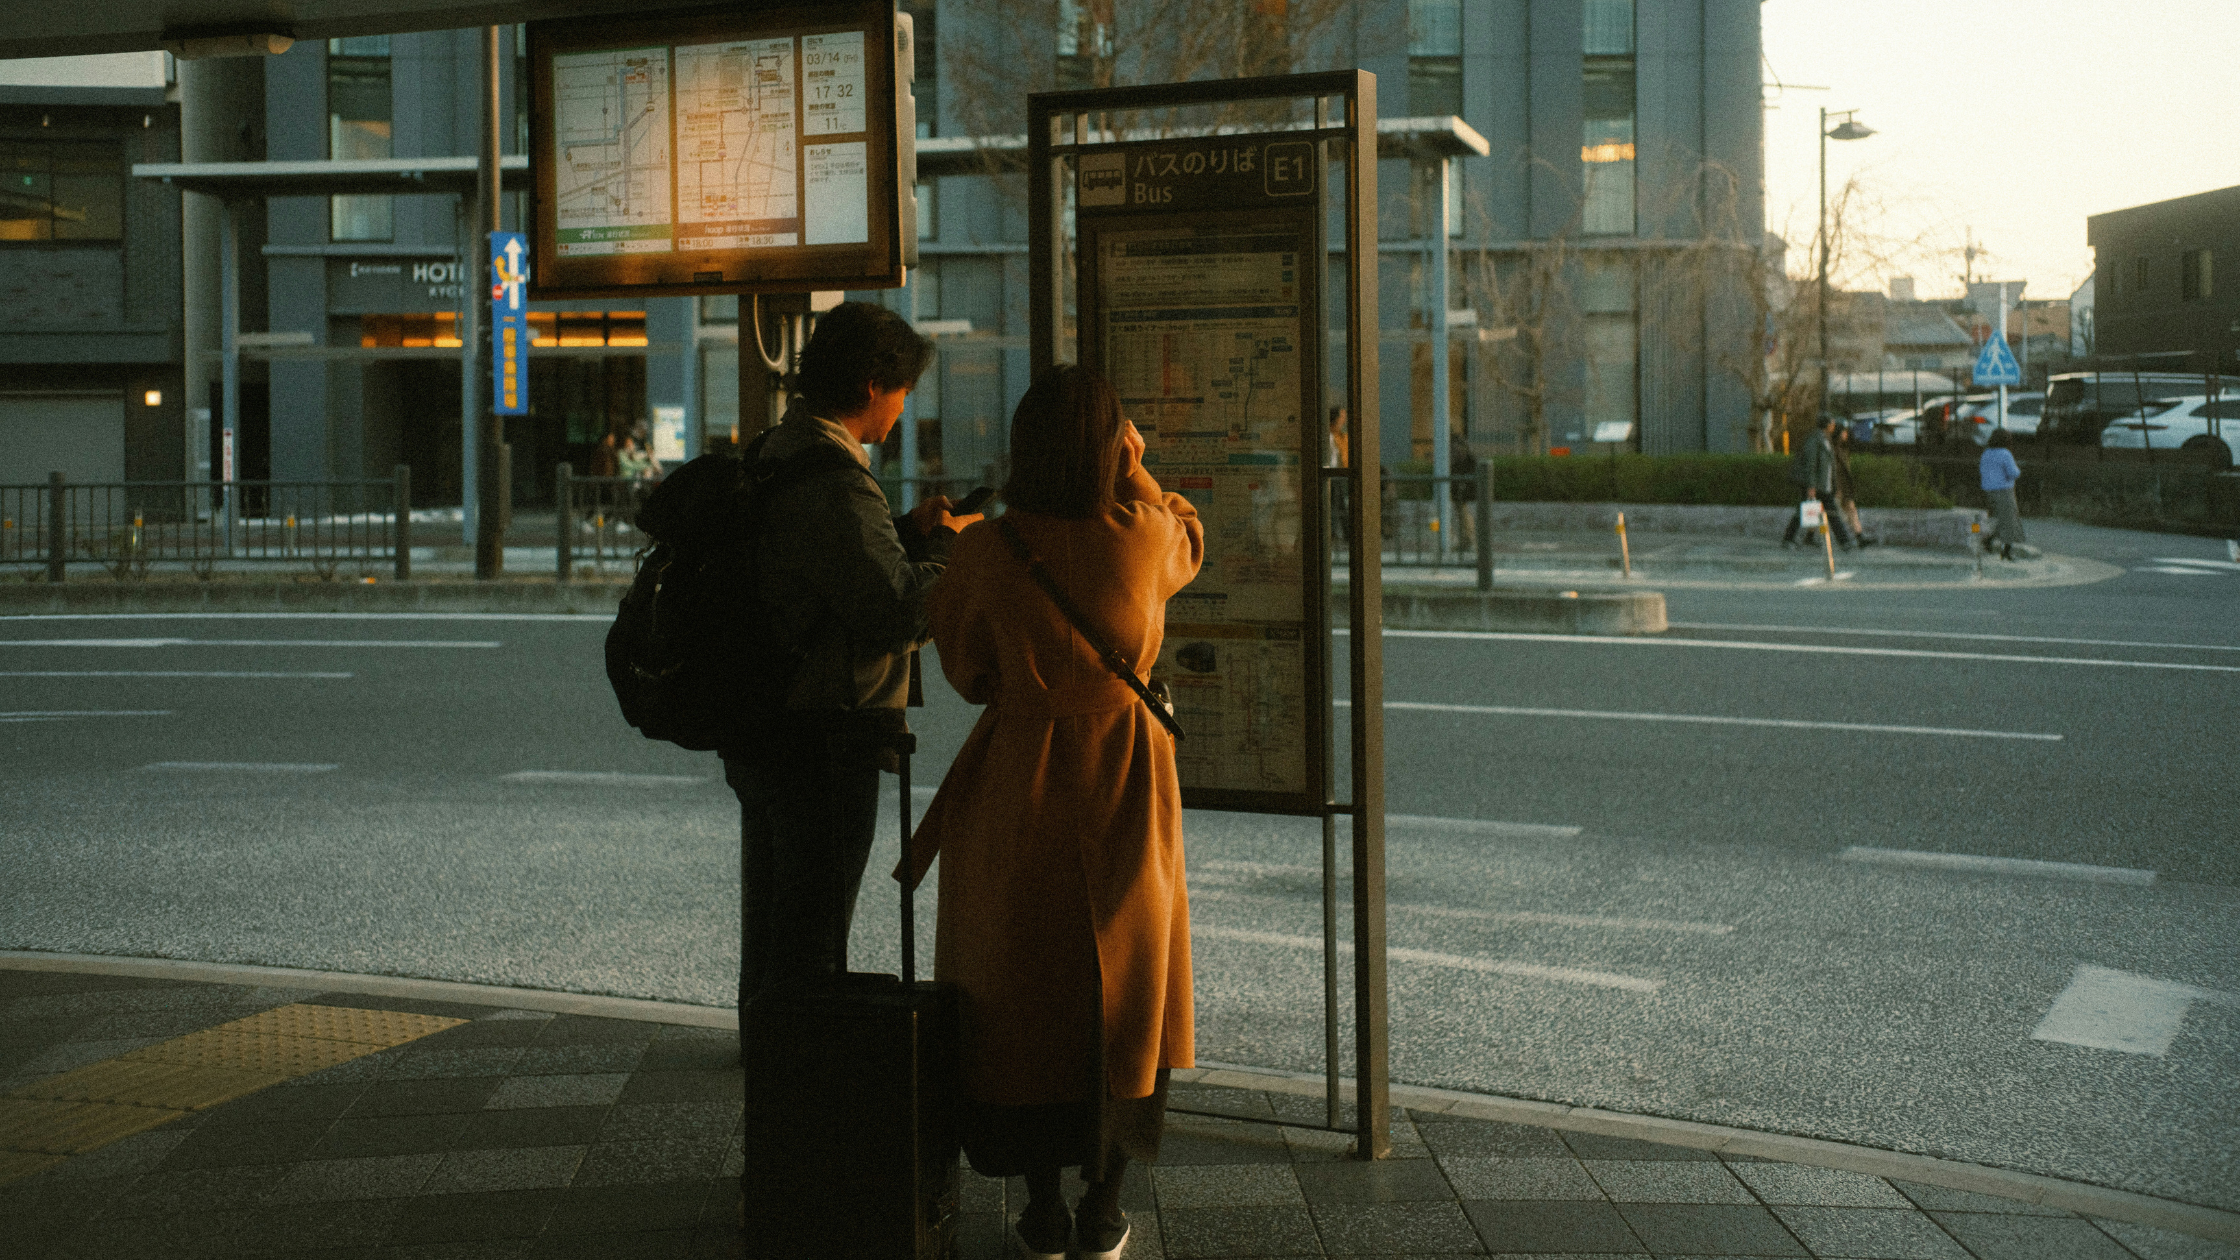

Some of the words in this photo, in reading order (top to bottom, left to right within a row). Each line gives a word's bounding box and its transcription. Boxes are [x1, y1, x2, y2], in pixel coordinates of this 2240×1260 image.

[807, 52, 840, 65] 03/14
[1133, 145, 1258, 178] バスのりば
[1274, 155, 1304, 182] E1
[1134, 182, 1173, 205] Bus
